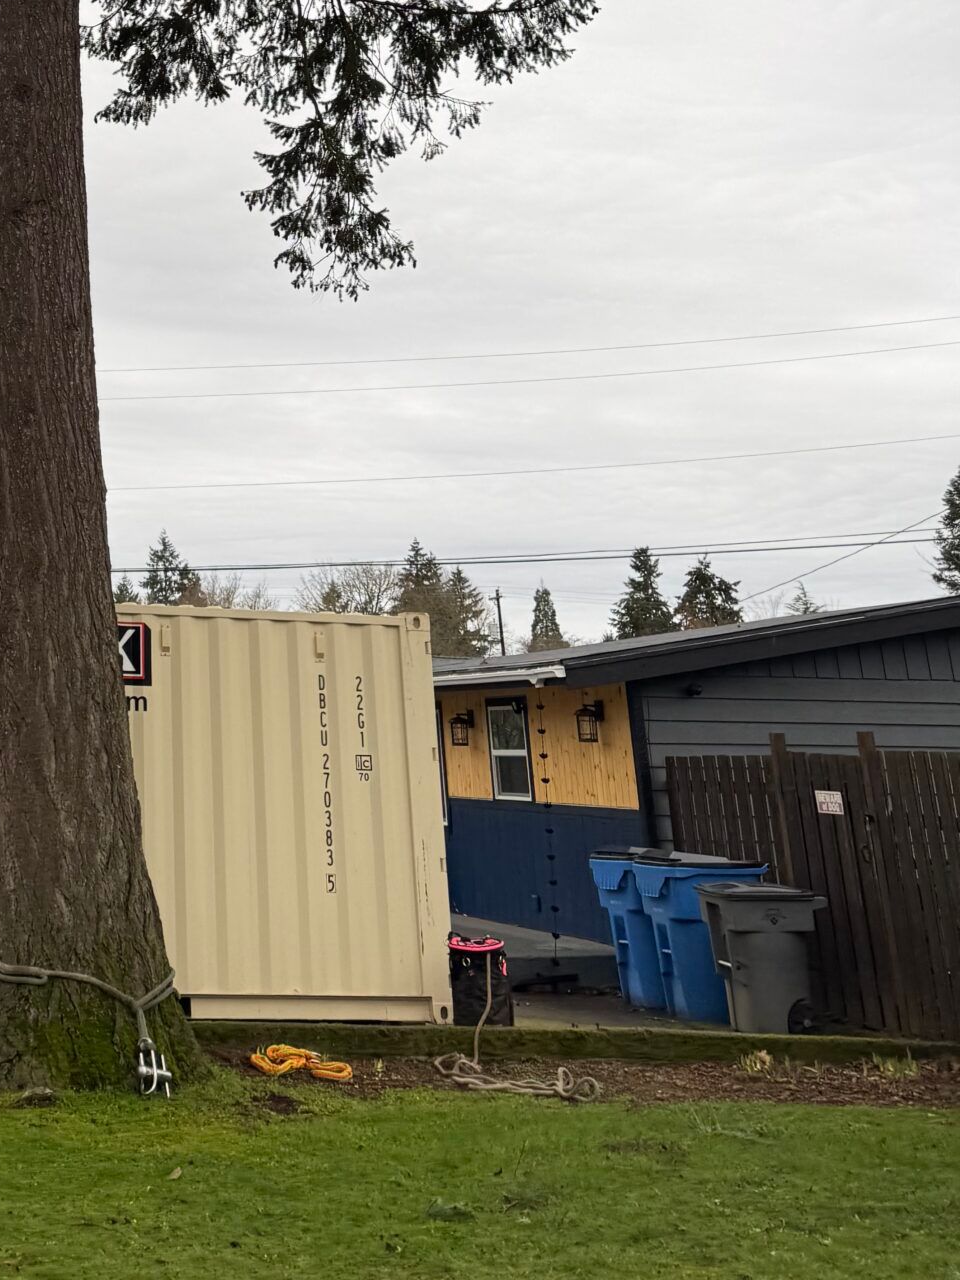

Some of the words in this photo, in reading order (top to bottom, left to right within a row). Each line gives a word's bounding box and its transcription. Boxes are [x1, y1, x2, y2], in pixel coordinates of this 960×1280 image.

[318, 674, 328, 747] DBCU
[355, 676, 365, 748] 22G1
[322, 753, 334, 866] 270383
[358, 772, 370, 781] 70
